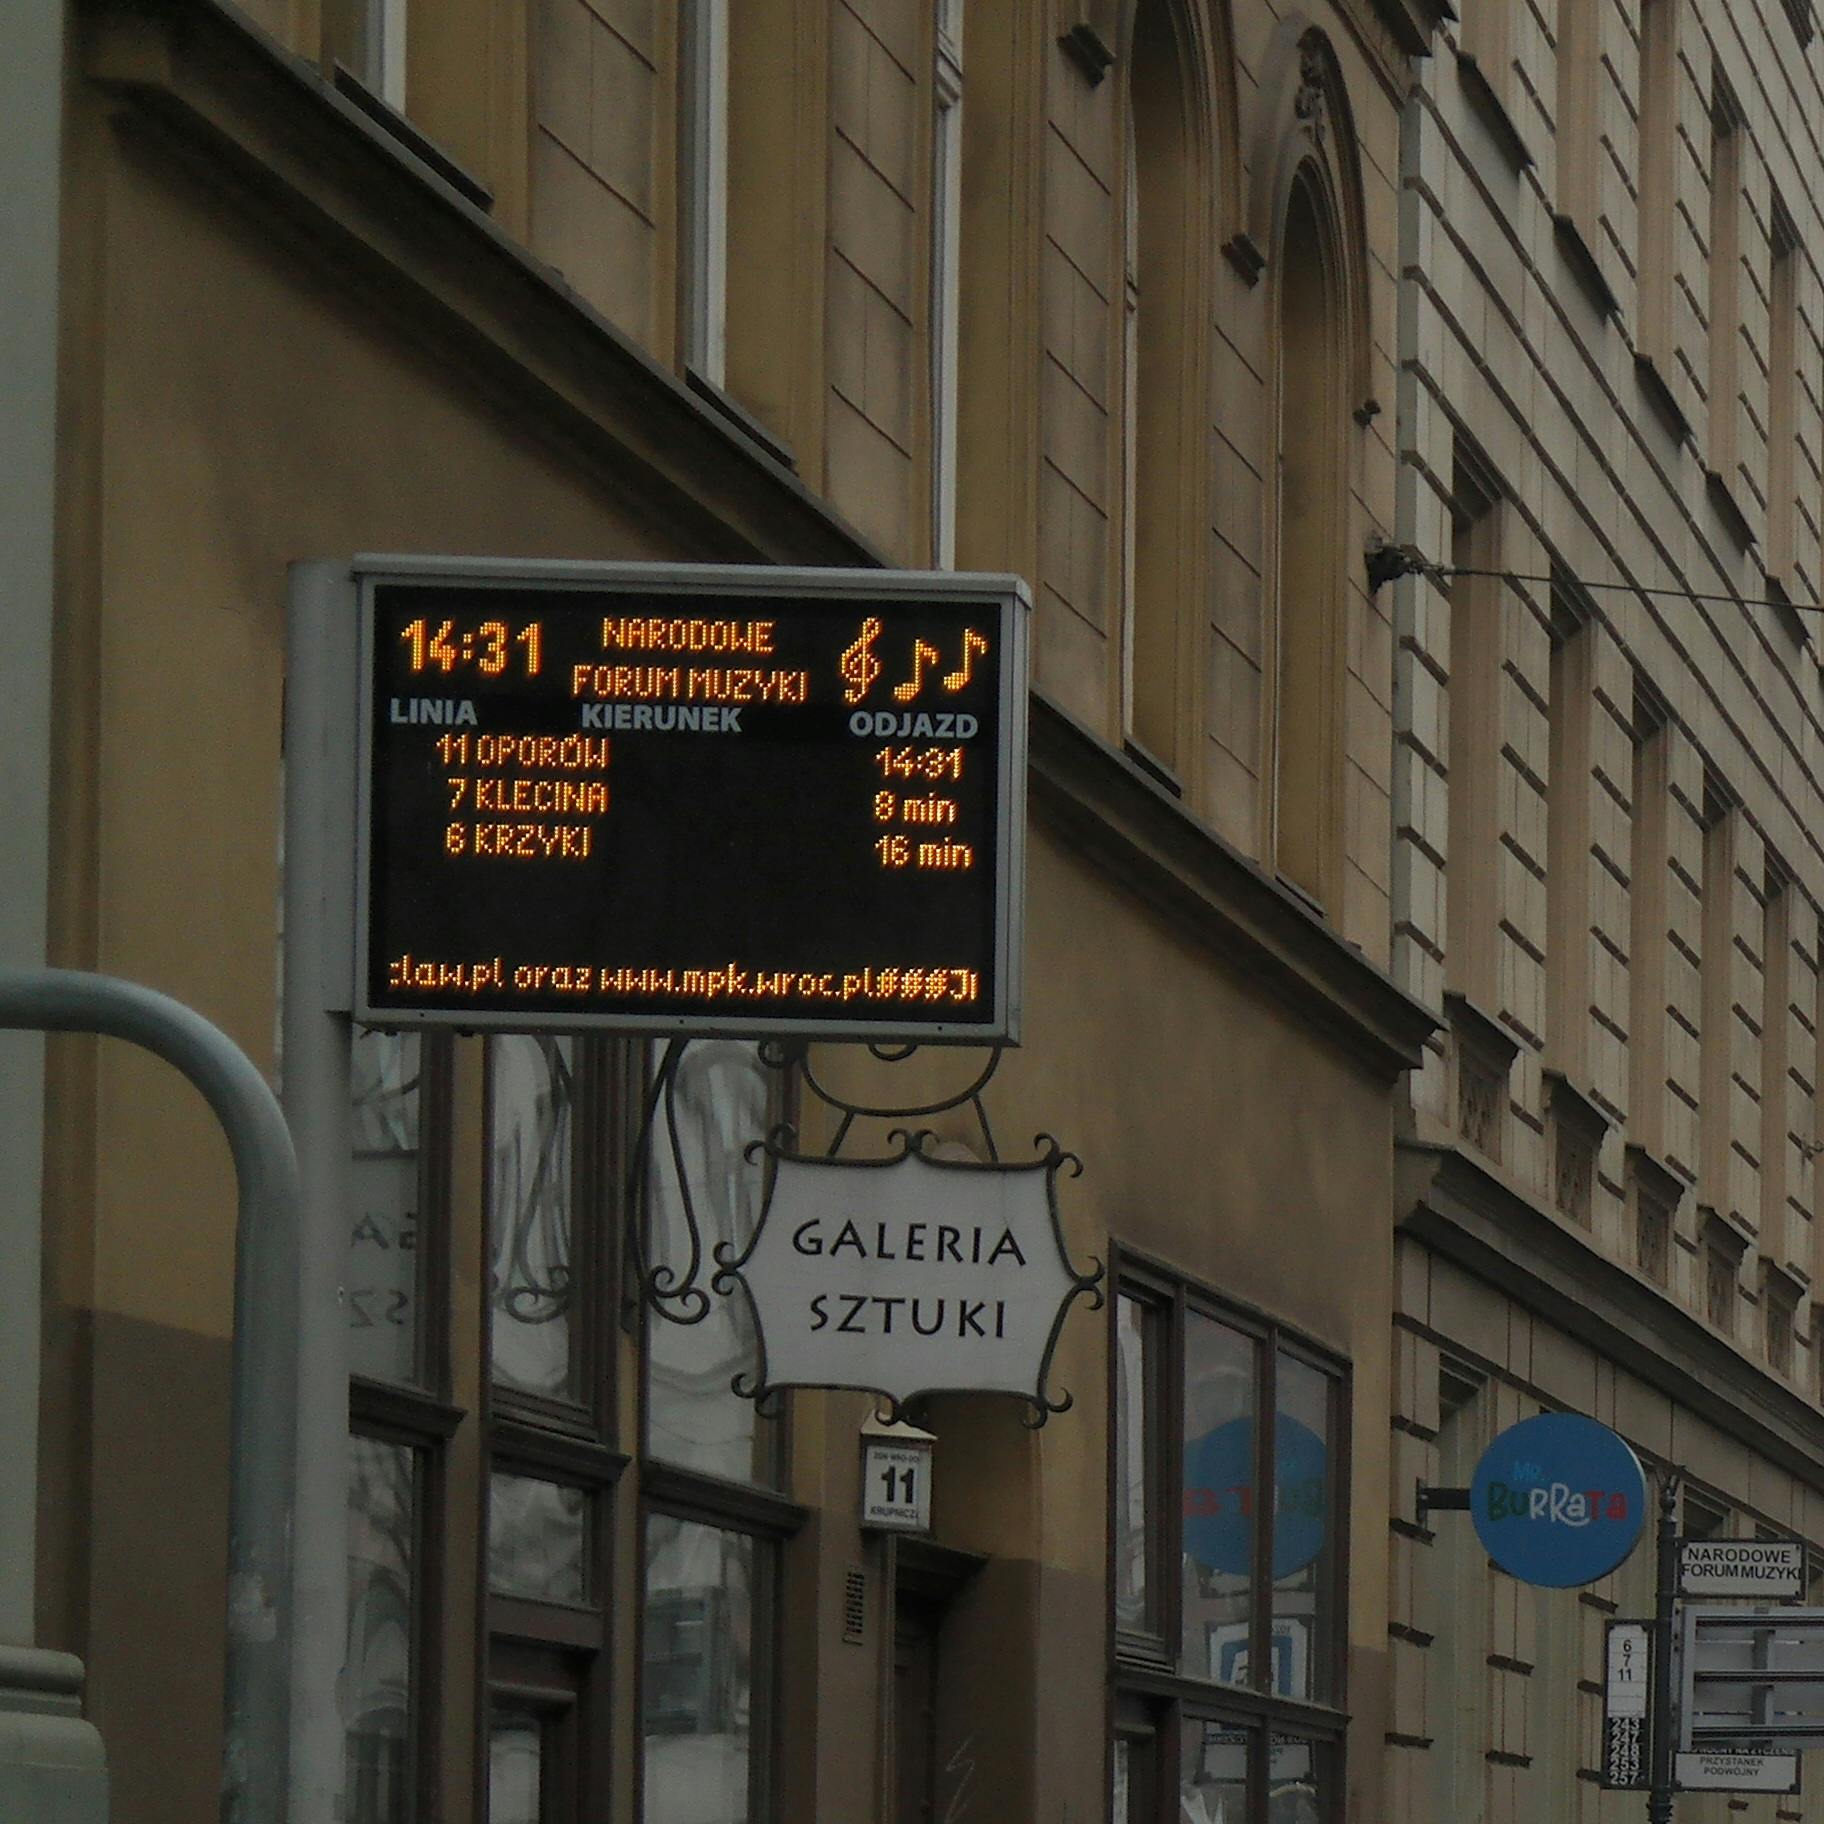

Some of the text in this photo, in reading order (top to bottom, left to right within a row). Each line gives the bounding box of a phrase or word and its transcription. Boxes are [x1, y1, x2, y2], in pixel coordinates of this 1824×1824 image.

[401, 618, 541, 674] 14:31
[602, 617, 775, 653] NARODOWE
[572, 664, 807, 702] FORUM MUZYKI
[390, 698, 479, 726] LINIA
[581, 703, 743, 733] KIERUNEK
[849, 710, 979, 739] ODJAZD
[436, 733, 963, 779] 11 OPORÓW 14:31
[447, 777, 957, 823] 7 KLECINA 8 min
[446, 822, 973, 867] 6 KRZYKI 16 min
[514, 965, 592, 990] oraz
[792, 1218, 1027, 1266] GALERIA
[810, 1294, 1005, 1339] SZTUKI
[881, 1466, 914, 1503] 11
[1687, 1547, 1792, 1564] NARODOWE
[1681, 1563, 1801, 1580] FORUM MUZYKI
[1622, 1639, 1632, 1653] 6
[1622, 1653, 1632, 1667] 7
[1617, 1668, 1632, 1681] 11
[1611, 1718, 1640, 1730] 243
[1611, 1730, 1639, 1744] 247
[1609, 1757, 1640, 1771] 253
[1699, 1755, 1765, 1767] PRZYSTANEK
[1703, 1765, 1760, 1776] PODWÓJNY
[1609, 1771, 1639, 1785] 257
